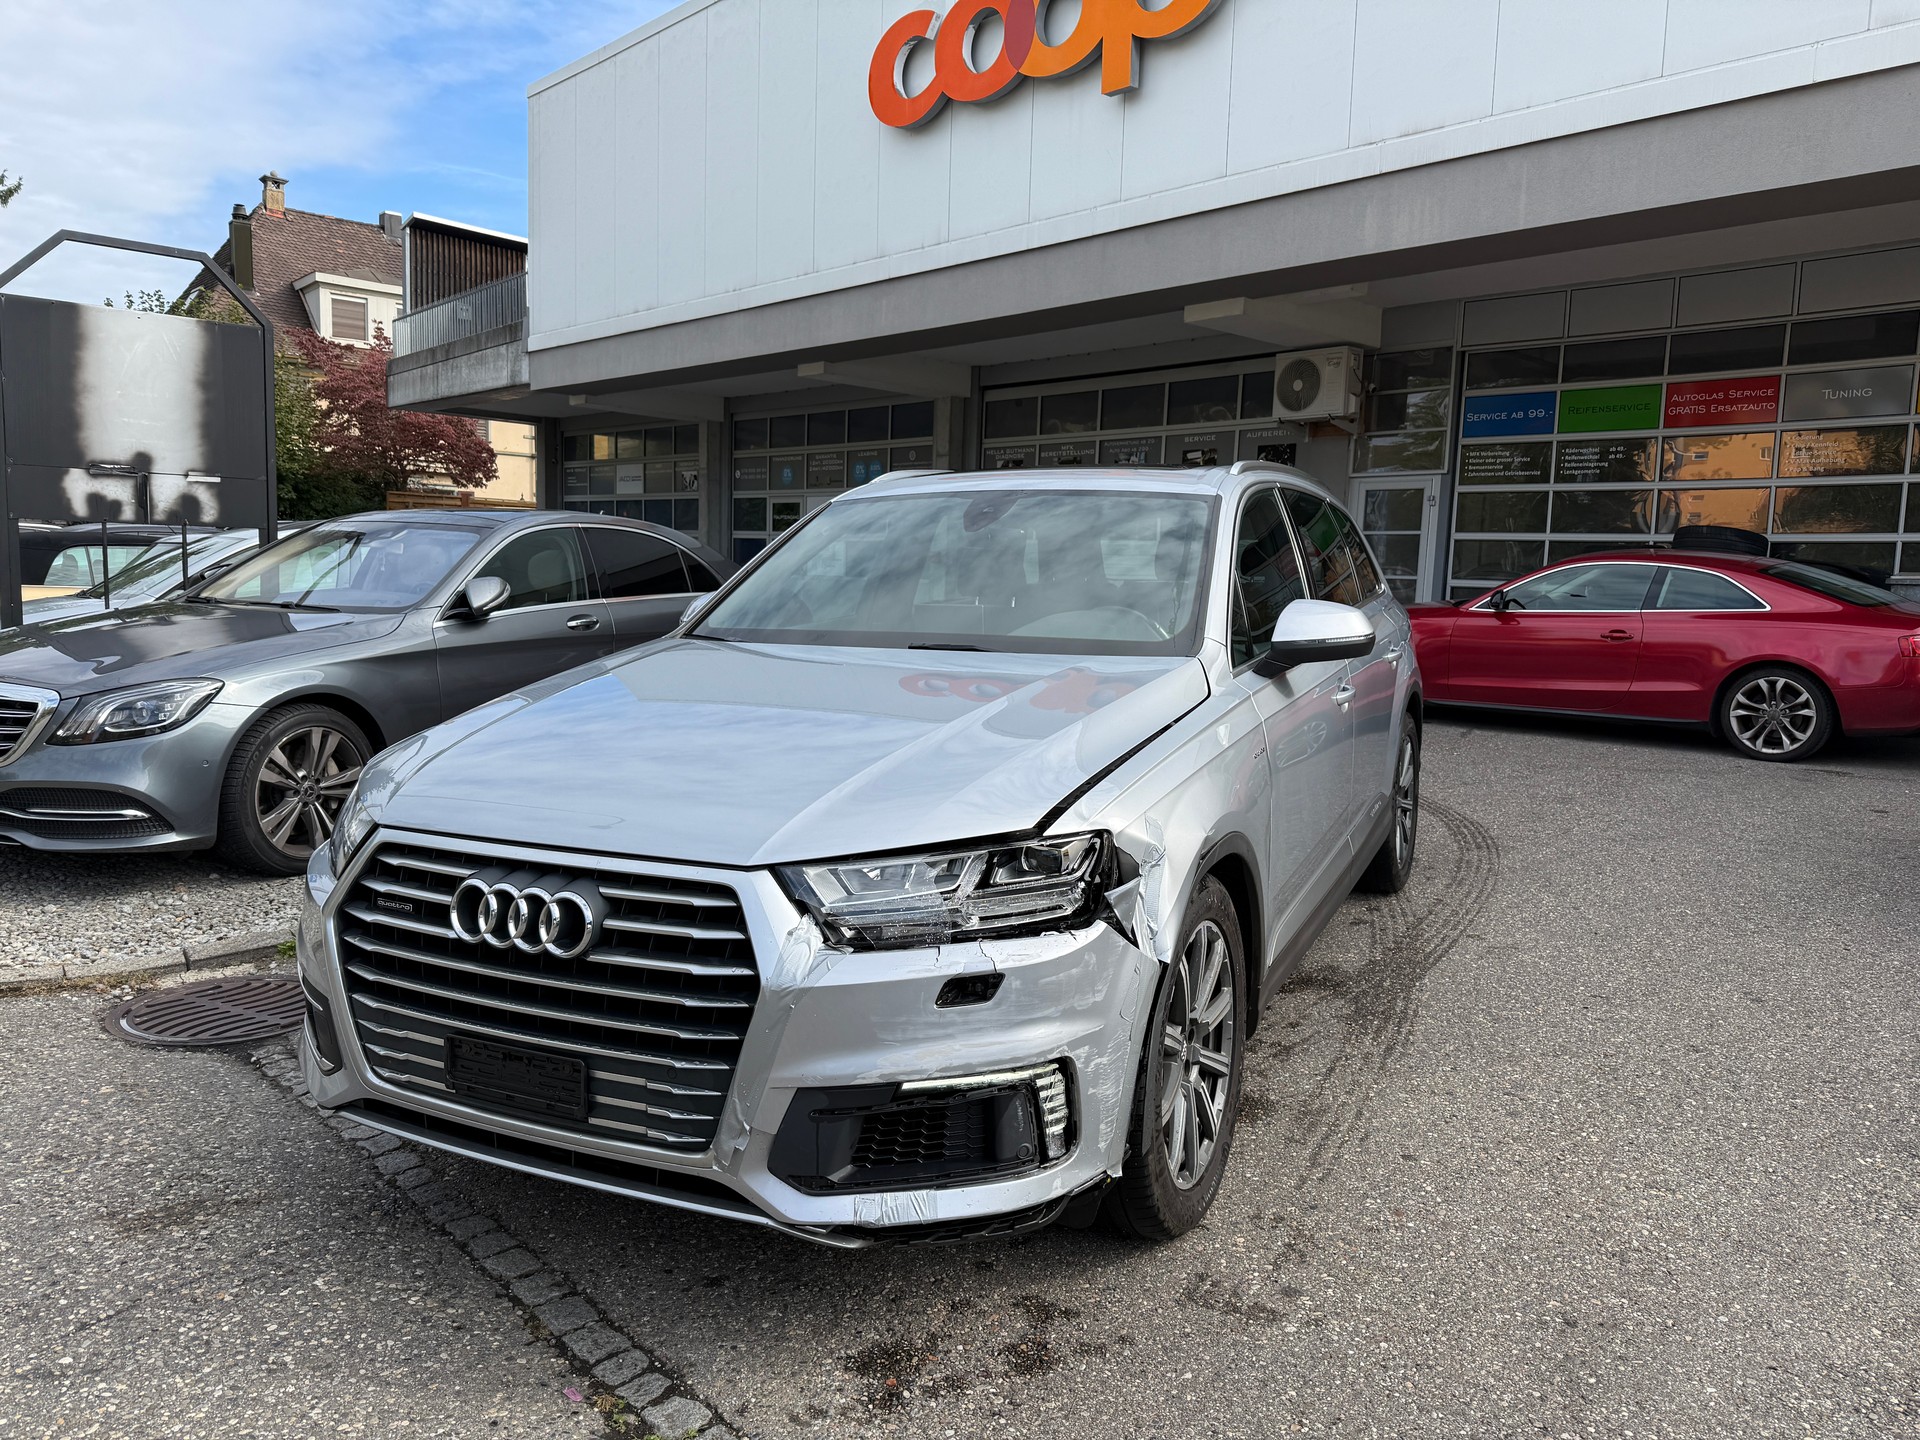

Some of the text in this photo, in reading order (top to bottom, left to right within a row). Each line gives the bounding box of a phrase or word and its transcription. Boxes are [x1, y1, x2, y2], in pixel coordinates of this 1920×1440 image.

[1670, 389, 1774, 402] AUTOGLAS SERVICE
[1822, 388, 1872, 400] TUNING
[1568, 403, 1651, 415] REIFENSERVICE
[1668, 402, 1776, 415] GRATIS ERSATZAUTO
[1466, 412, 1508, 422] SERVICE
[1041, 449, 1094, 457] BEREITSTELLUNG
[377, 900, 410, 911] quattro
